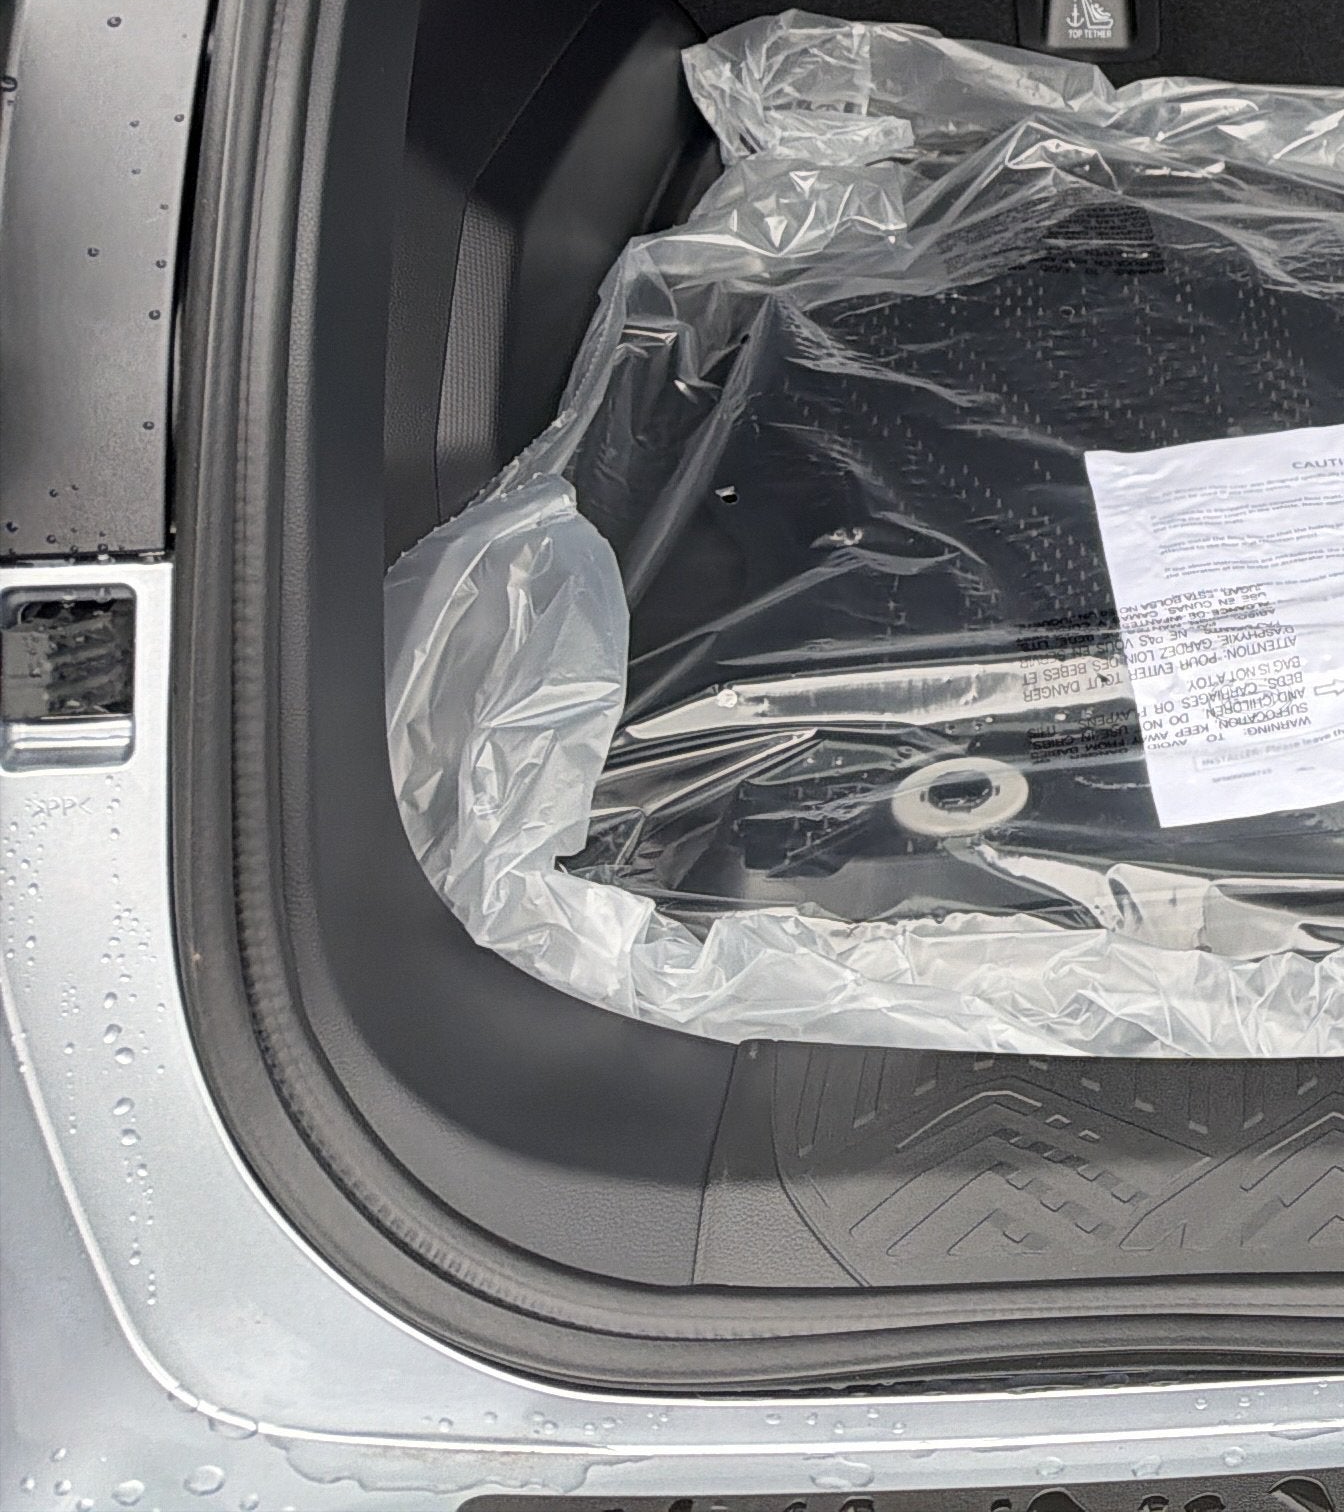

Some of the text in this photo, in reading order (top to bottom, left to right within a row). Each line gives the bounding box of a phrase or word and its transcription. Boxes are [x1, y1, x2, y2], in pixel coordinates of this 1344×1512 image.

[1118, 603, 1138, 614] NO
[1117, 610, 1160, 622] CAMA
[1169, 629, 1188, 642] NE
[1070, 645, 1090, 658] EN
[1095, 638, 1134, 654] VOUS
[1159, 638, 1213, 659] GARDEZ
[1124, 649, 1155, 664] LOIN
[1273, 655, 1300, 672] BAG
[1022, 635, 1297, 702] ATTENTION: POUR EVITER TOUT DANGER
[1092, 656, 1119, 672] DES
[1258, 662, 1270, 675] IS
[1021, 672, 1038, 686] ET
[1042, 663, 1087, 681] BEBES
[1214, 672, 1226, 682] A
[1228, 666, 1256, 681] NOT
[1181, 682, 1258, 710] CARRIAGES
[1276, 686, 1306, 703] AND
[1153, 700, 1175, 713] OR
[1136, 718, 1163, 733] NO
[1168, 712, 1190, 726] DO
[1242, 716, 1312, 736] WARNING:
[1026, 725, 1057, 739] THIS
[1100, 723, 1128, 738] USE
[1174, 723, 1210, 738] KEEP
[1084, 738, 1125, 751] FROM
[1146, 739, 1188, 751] AVOID
[1206, 733, 1224, 743] TO
[1302, 733, 1332, 746] leave
